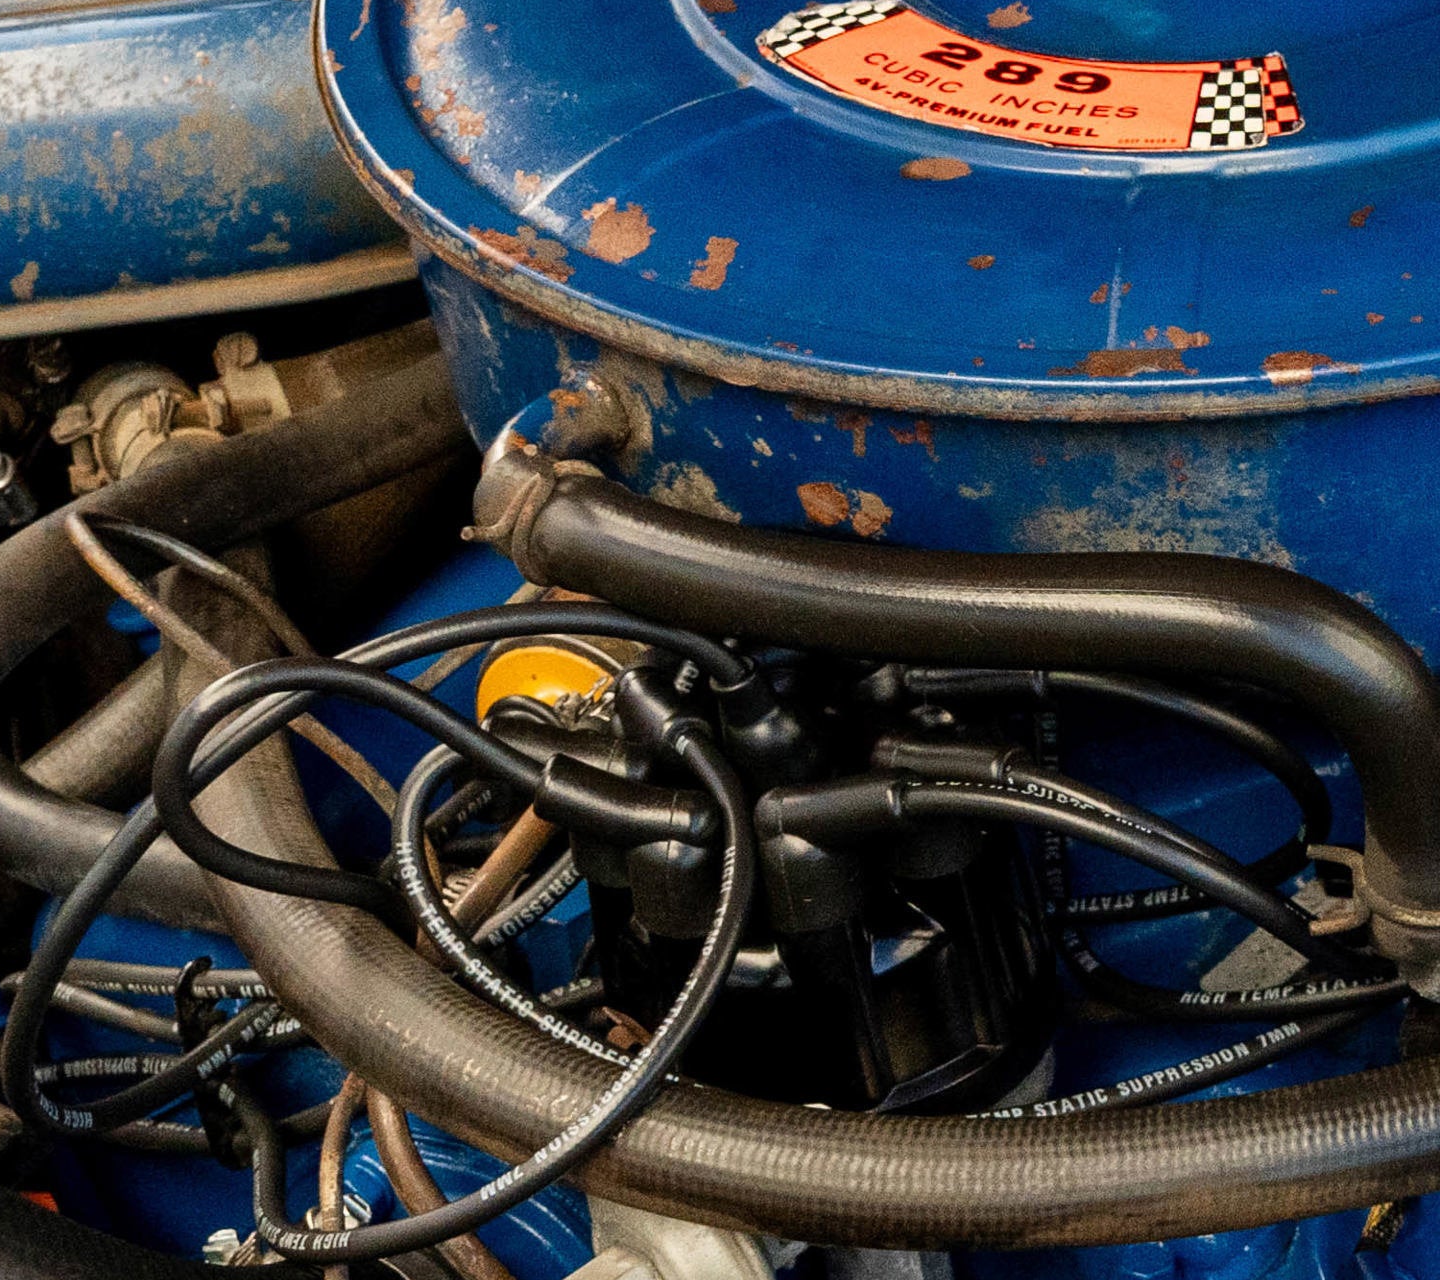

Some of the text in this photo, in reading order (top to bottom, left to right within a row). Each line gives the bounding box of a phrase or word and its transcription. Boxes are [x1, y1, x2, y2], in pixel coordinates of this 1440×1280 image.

[863, 52, 964, 94] CUBIC
[989, 91, 1139, 120] INCHES
[920, 41, 1112, 95] 289
[854, 76, 1100, 139] 4V-PREMIUM FUEL
[420, 902, 466, 955] TEMP
[465, 958, 534, 1018] STATIC
[1032, 1022, 1301, 1120] STATIC SUPPRESSION 7MM
[479, 1166, 525, 1201] 7MM
[312, 1230, 350, 1249] HIGH
